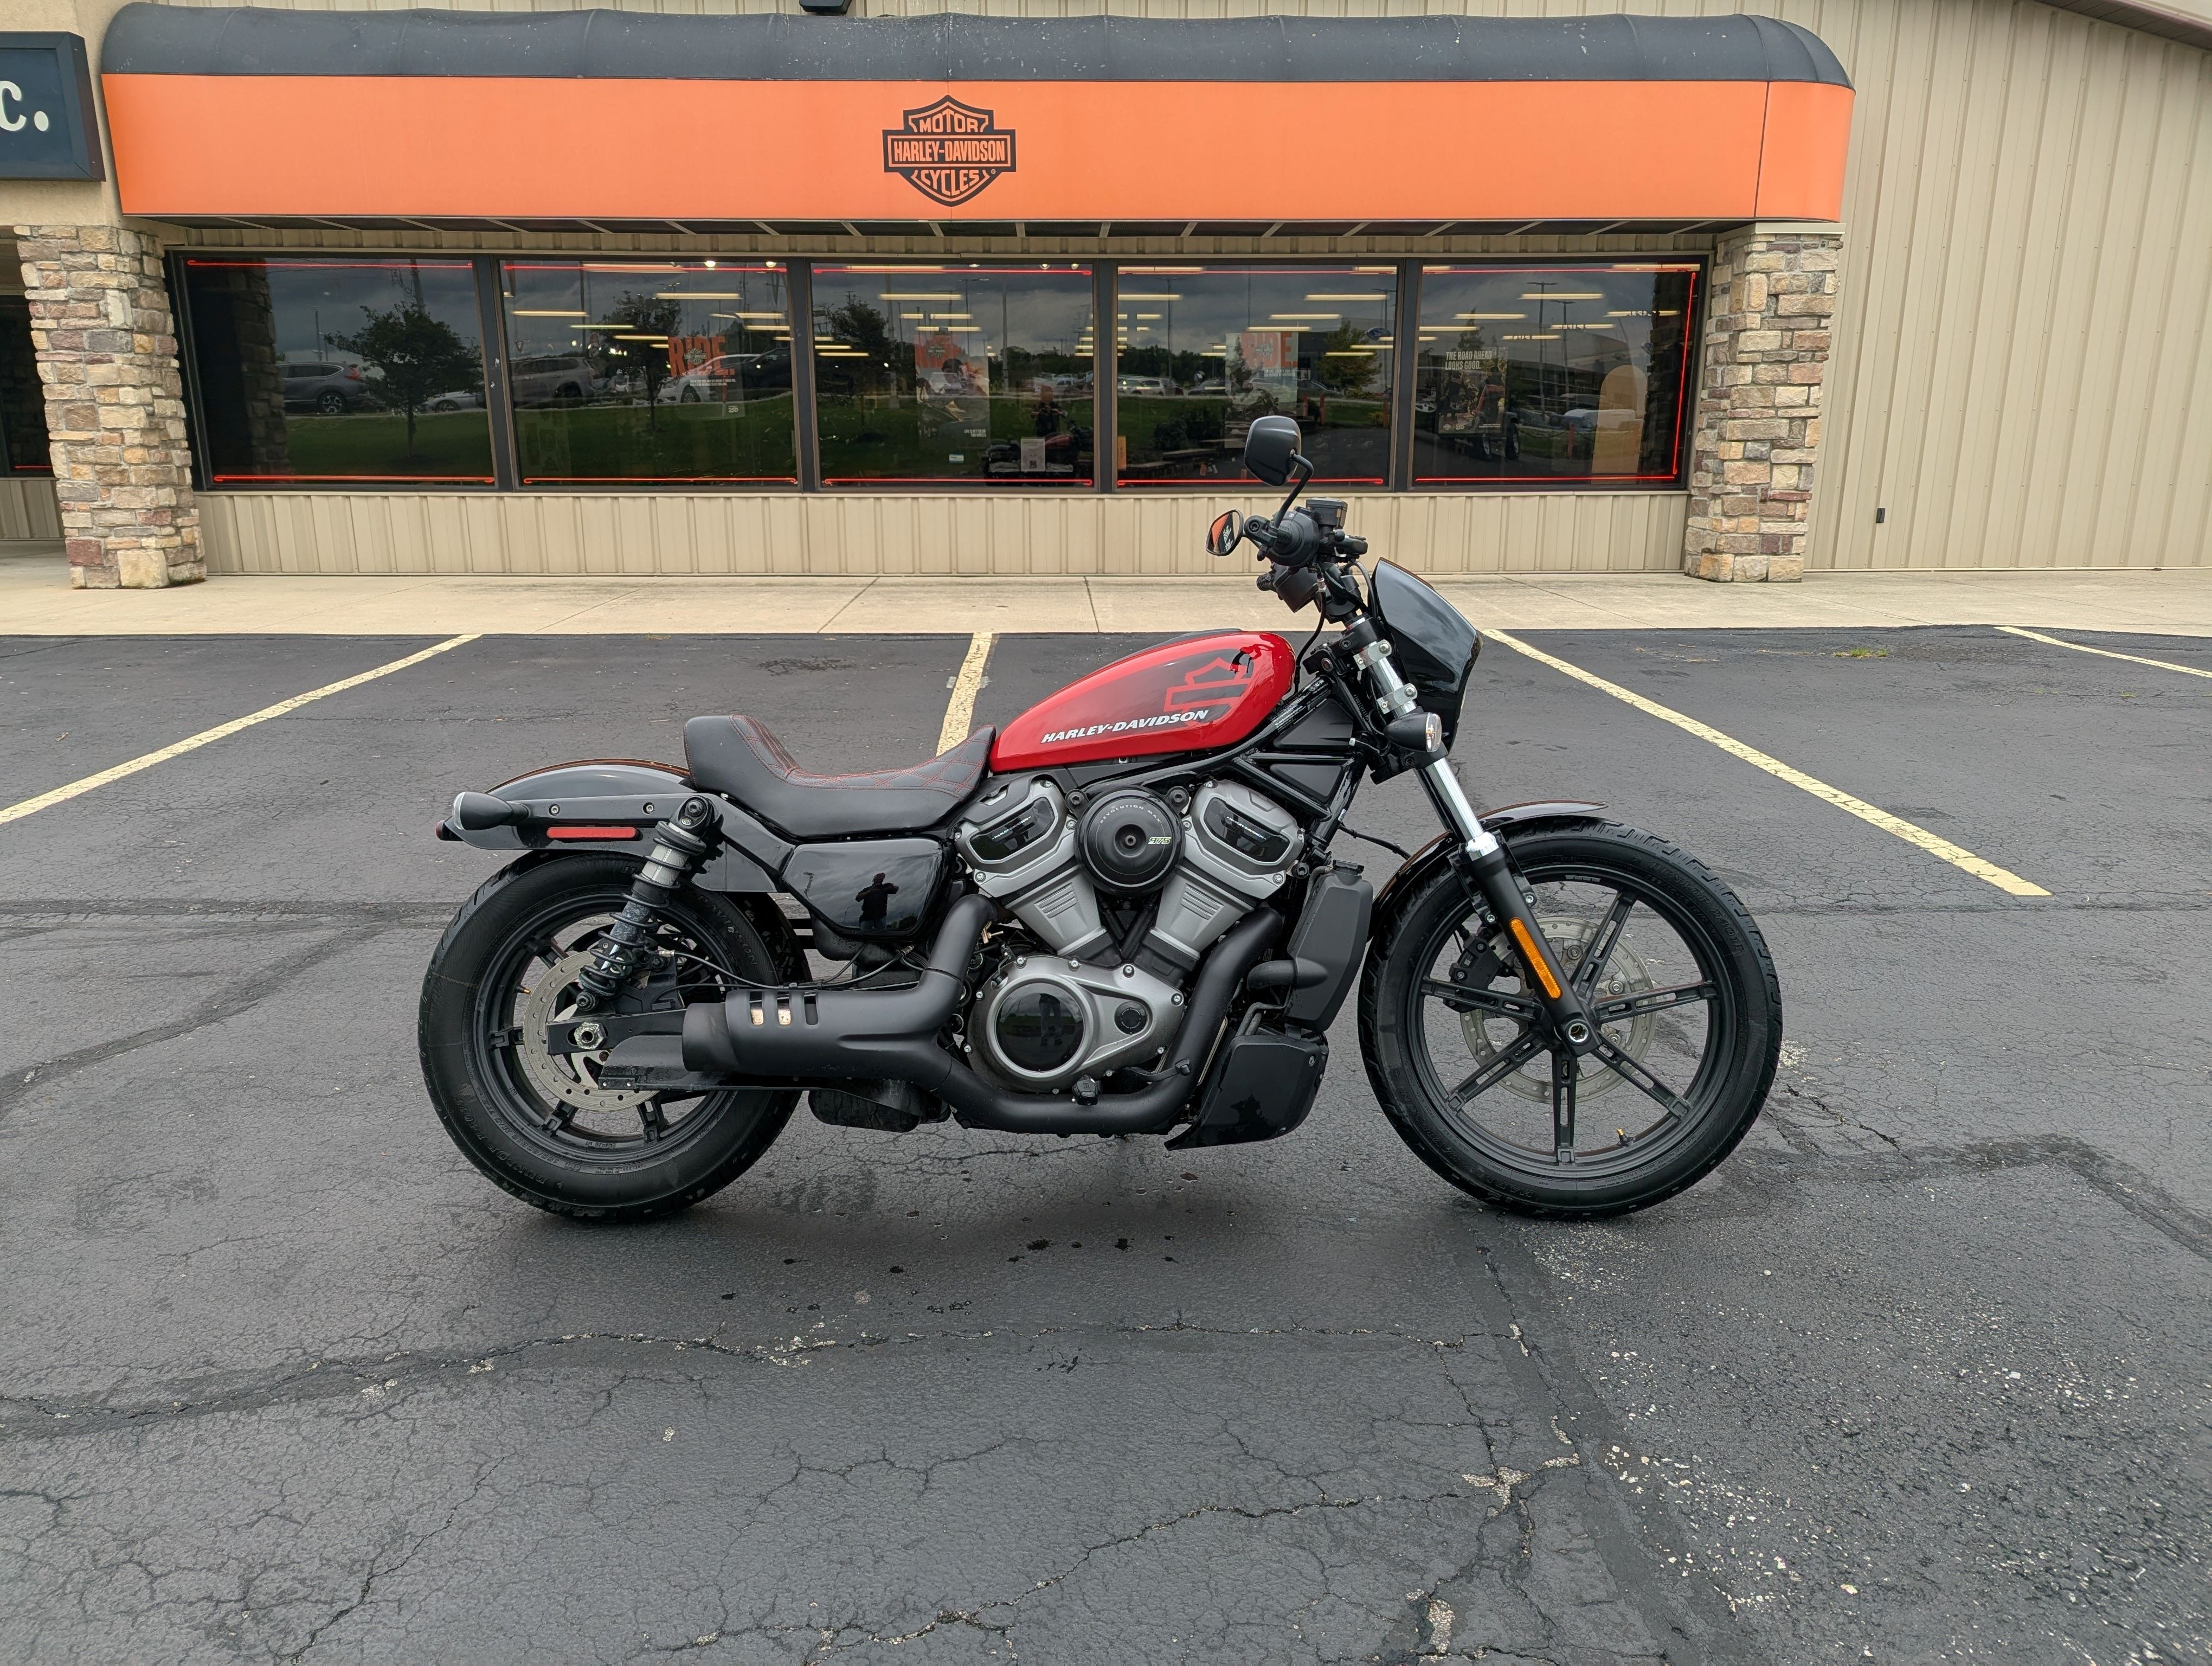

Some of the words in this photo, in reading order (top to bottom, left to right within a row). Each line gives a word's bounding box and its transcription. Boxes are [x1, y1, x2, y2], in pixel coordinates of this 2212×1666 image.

[919, 108, 978, 133] MOTOR
[894, 140, 1005, 162] HARLEY-DAVIDSON
[920, 169, 980, 196] CYCLES
[1445, 361, 1463, 370] LOOKS
[1464, 361, 1481, 369] GOOD.
[1446, 351, 1457, 360] THE
[1457, 351, 1472, 360] ROAD
[1474, 350, 1492, 360] AHEAD
[1041, 709, 1209, 744] HARLEY-DAVIDSON
[1100, 804, 1144, 824] REVOLUTION
